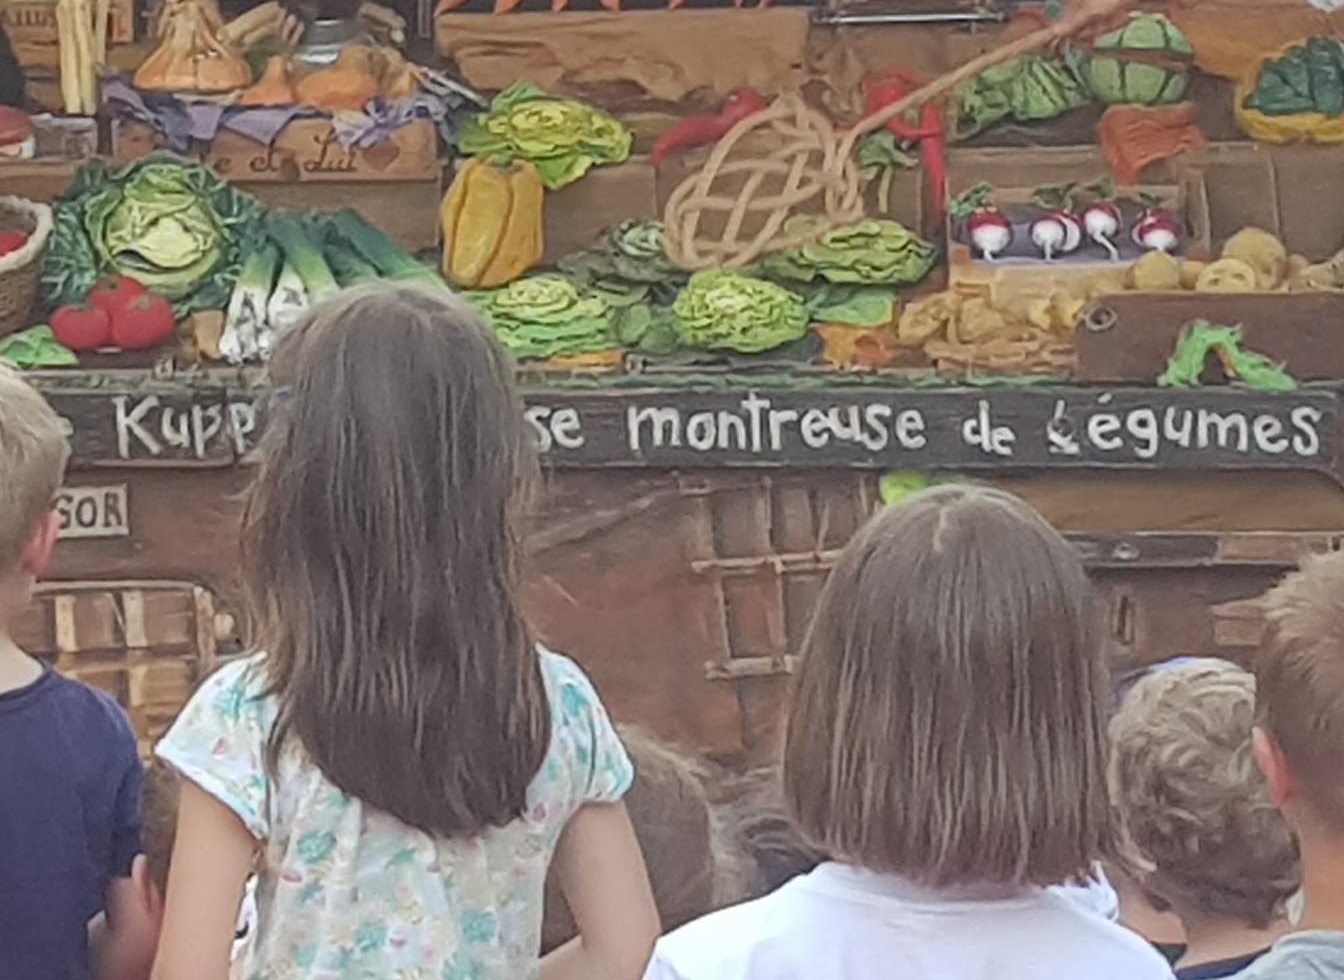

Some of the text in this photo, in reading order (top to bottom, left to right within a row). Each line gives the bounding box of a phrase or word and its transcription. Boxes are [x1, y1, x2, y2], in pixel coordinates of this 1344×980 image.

[112, 394, 256, 459] Kupp
[523, 406, 584, 453] se
[628, 392, 927, 453] montreuse
[962, 396, 1016, 457] de
